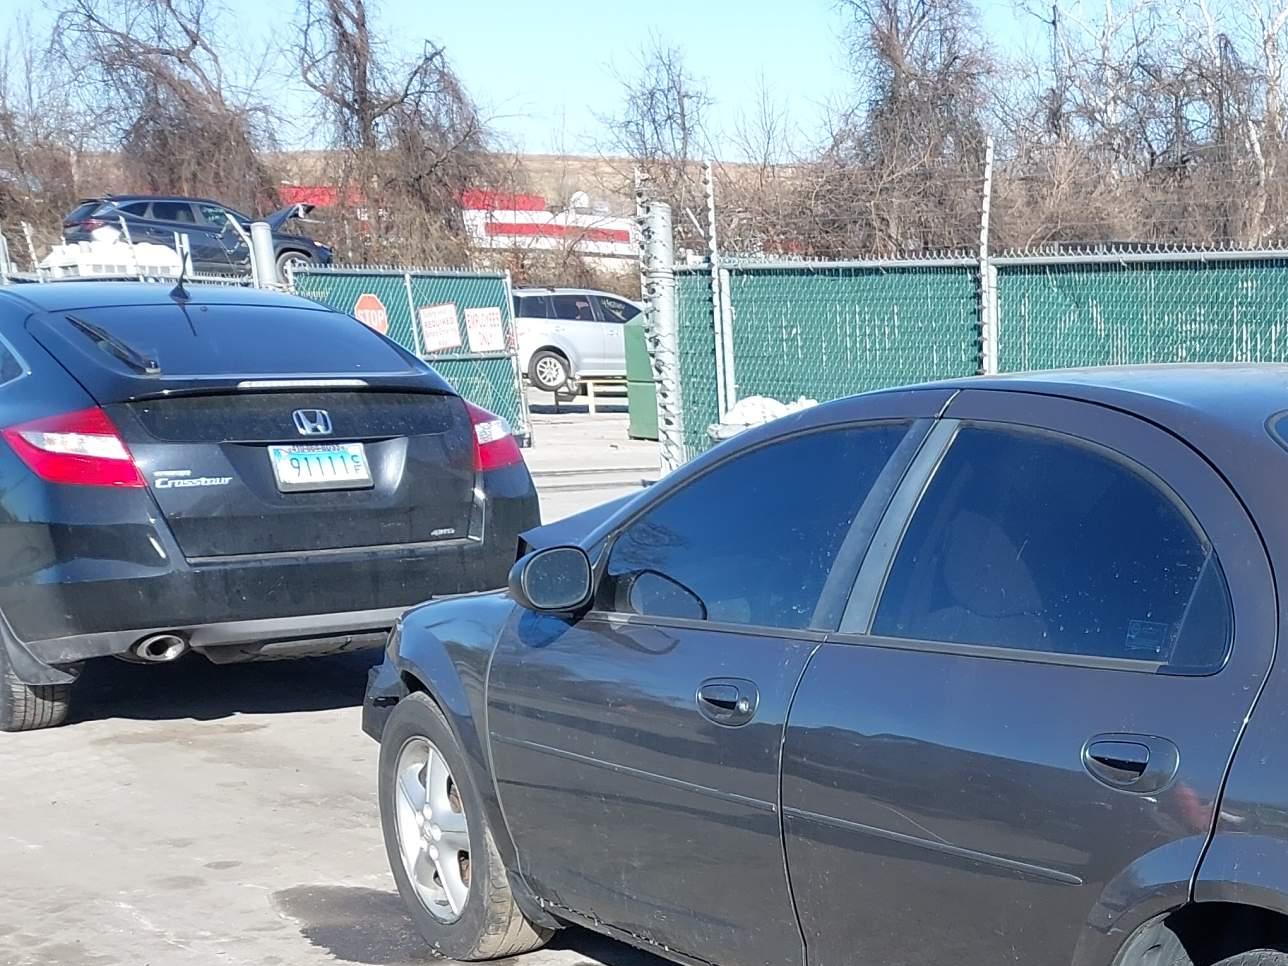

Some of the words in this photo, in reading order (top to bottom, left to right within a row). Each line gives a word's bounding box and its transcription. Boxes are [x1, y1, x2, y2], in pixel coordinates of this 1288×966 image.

[359, 309, 384, 328] STOP
[289, 454, 349, 478] 91111
[154, 477, 232, 488] Crosstour
